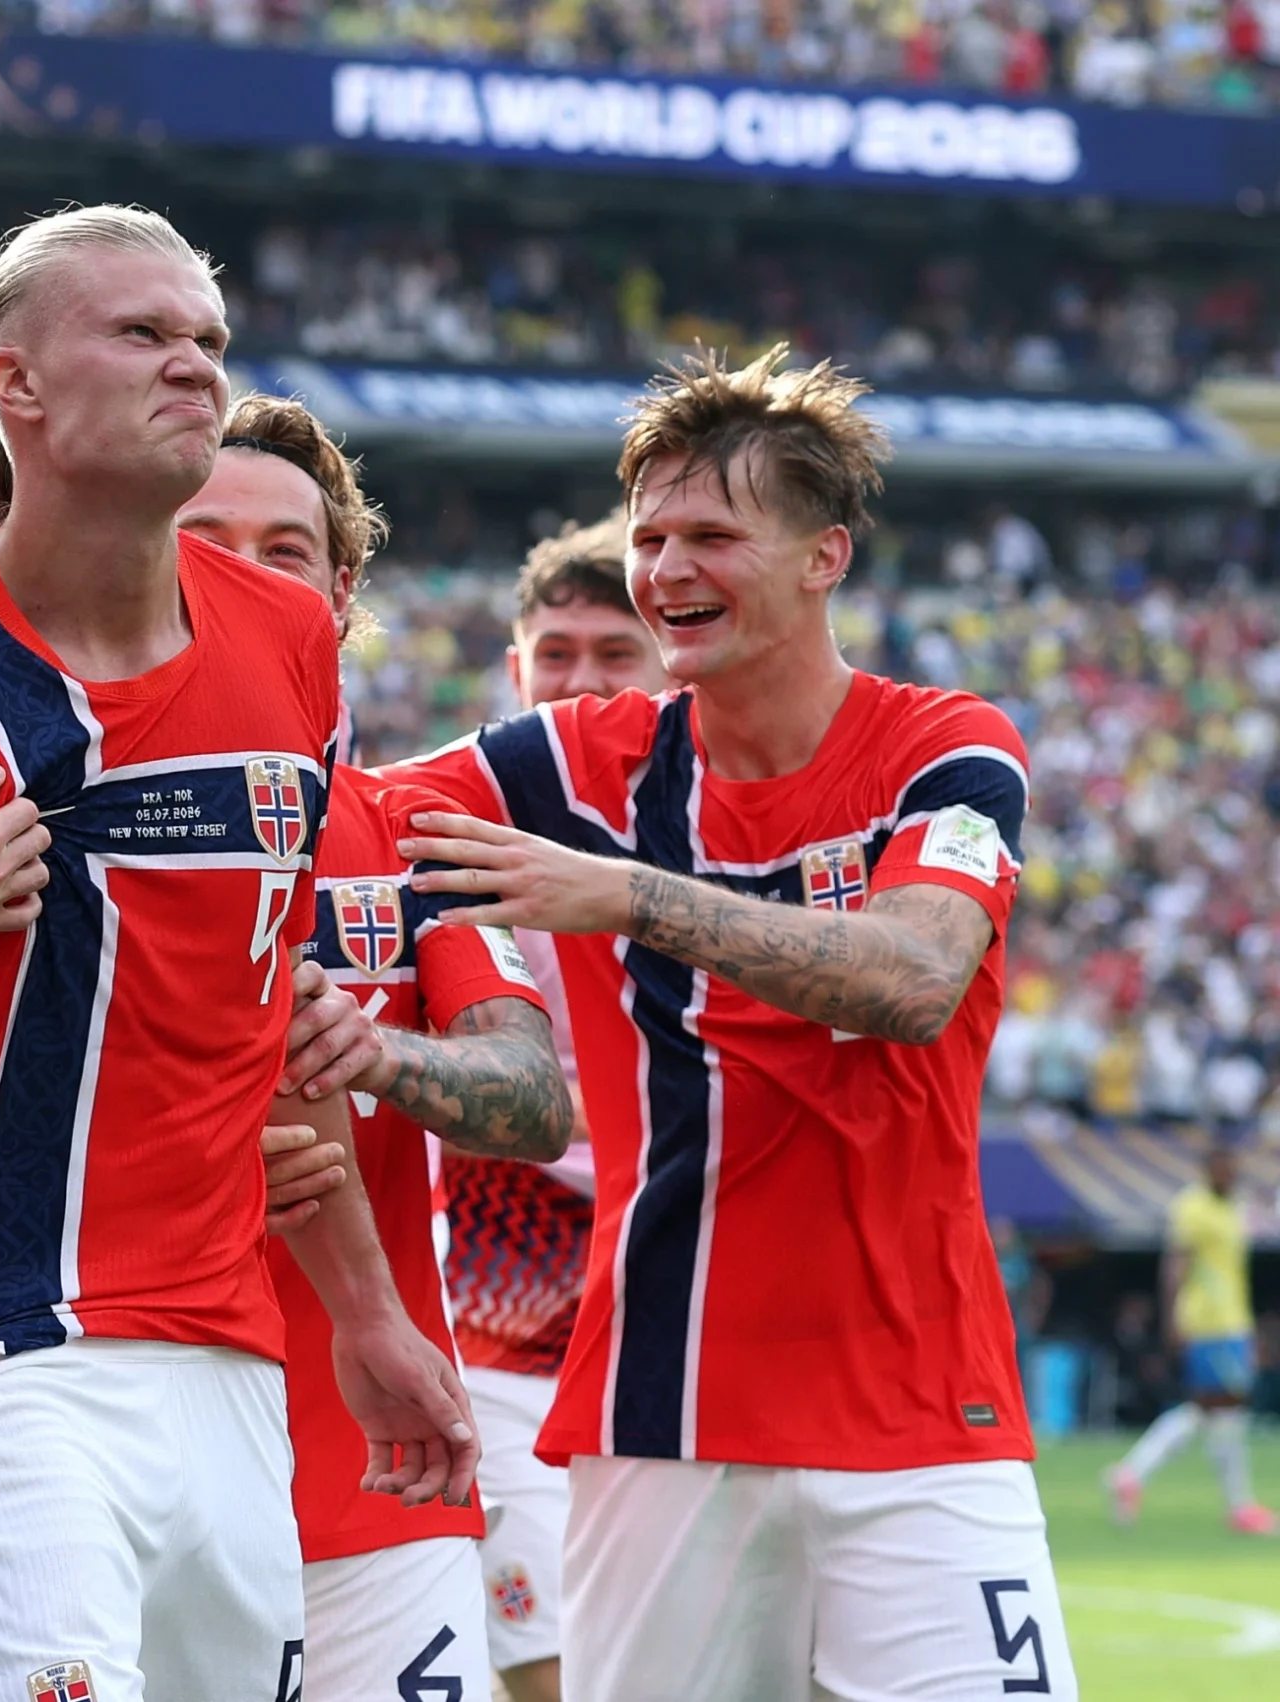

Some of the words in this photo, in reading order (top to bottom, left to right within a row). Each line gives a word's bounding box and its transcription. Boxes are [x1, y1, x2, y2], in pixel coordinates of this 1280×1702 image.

[331, 63, 482, 146] FIFA
[483, 74, 719, 160] WORLD
[721, 88, 853, 167] CUP
[852, 98, 1080, 184] 2026
[136, 806, 201, 821] 05.07.2026
[142, 791, 163, 804] BRA
[174, 788, 194, 803] NOR
[108, 827, 132, 839] NEW
[134, 826, 164, 838] YORK
[166, 825, 189, 838] NEW
[191, 823, 227, 837] JERSEY
[248, 870, 298, 1005] 9
[979, 1578, 1051, 1695] 5
